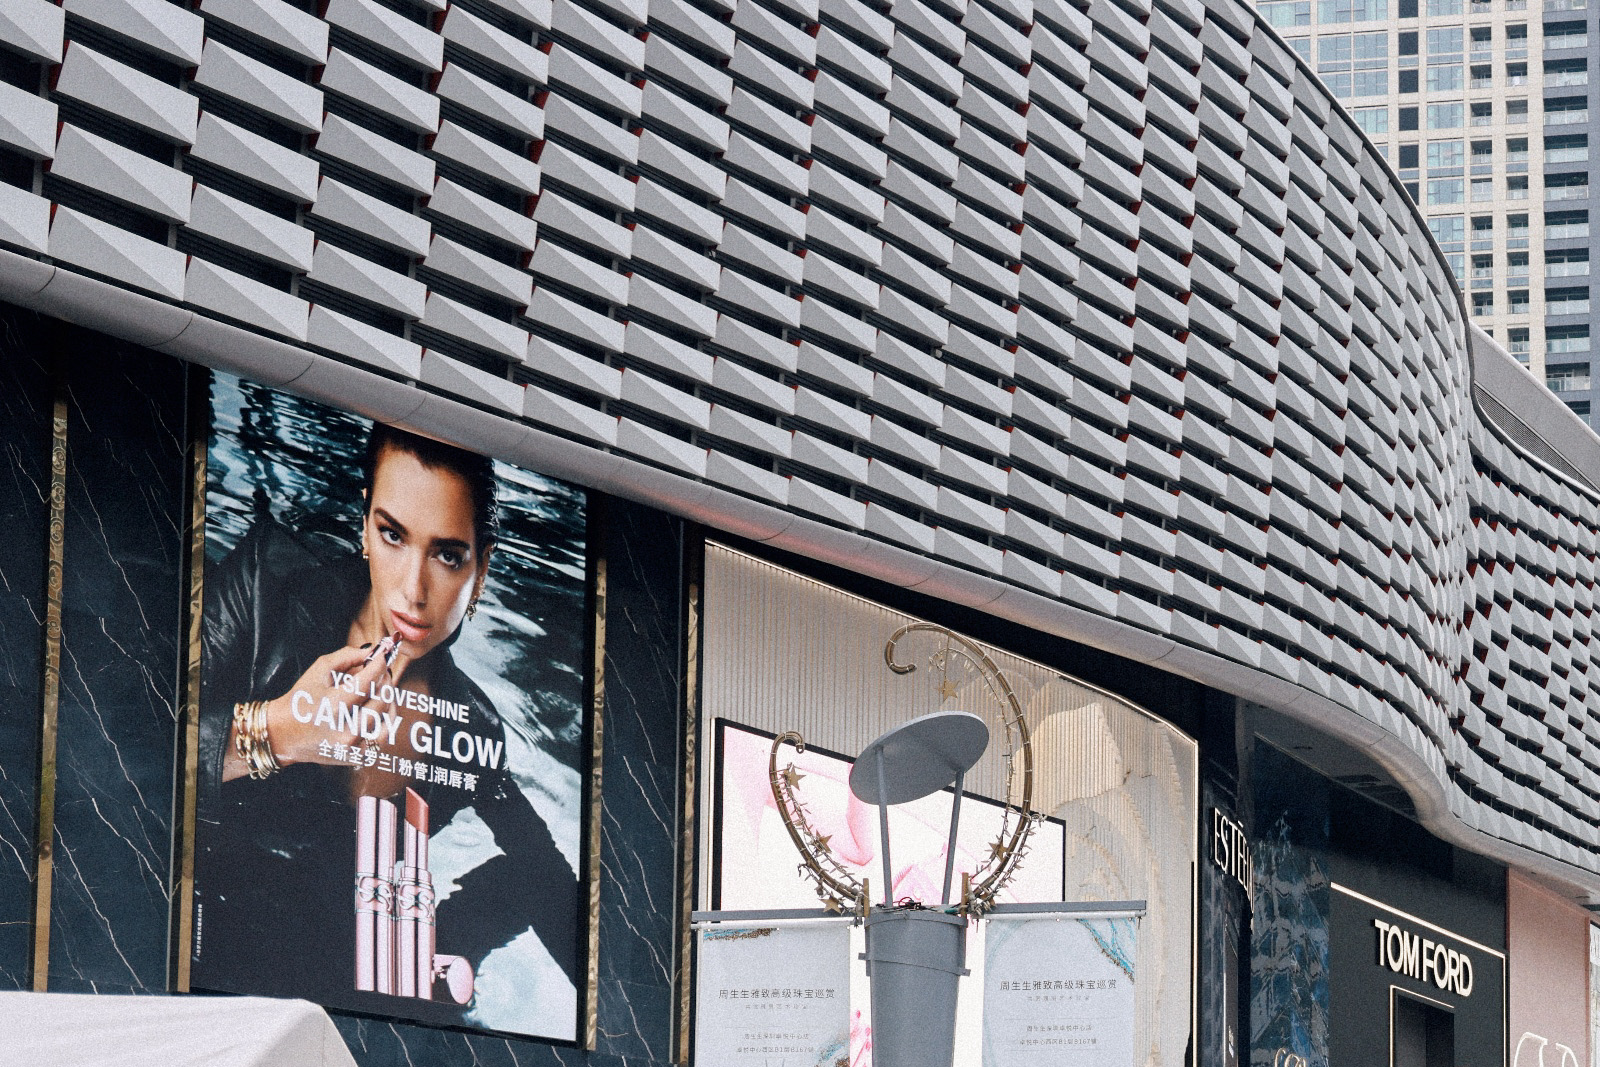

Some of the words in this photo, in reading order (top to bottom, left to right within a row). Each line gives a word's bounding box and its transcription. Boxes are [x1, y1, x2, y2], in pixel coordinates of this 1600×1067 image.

[331, 671, 366, 697] YSL
[370, 681, 470, 723] LOVESHINE
[291, 690, 403, 746] CANDY
[410, 721, 503, 770] GLOW
[1374, 919, 1420, 979] TOM
[1422, 938, 1473, 997] FORD
[719, 988, 835, 999] 周生生雅致高级珠宝巡赏
[1000, 979, 1117, 991] 周生生雅致高级珠宝巡赏
